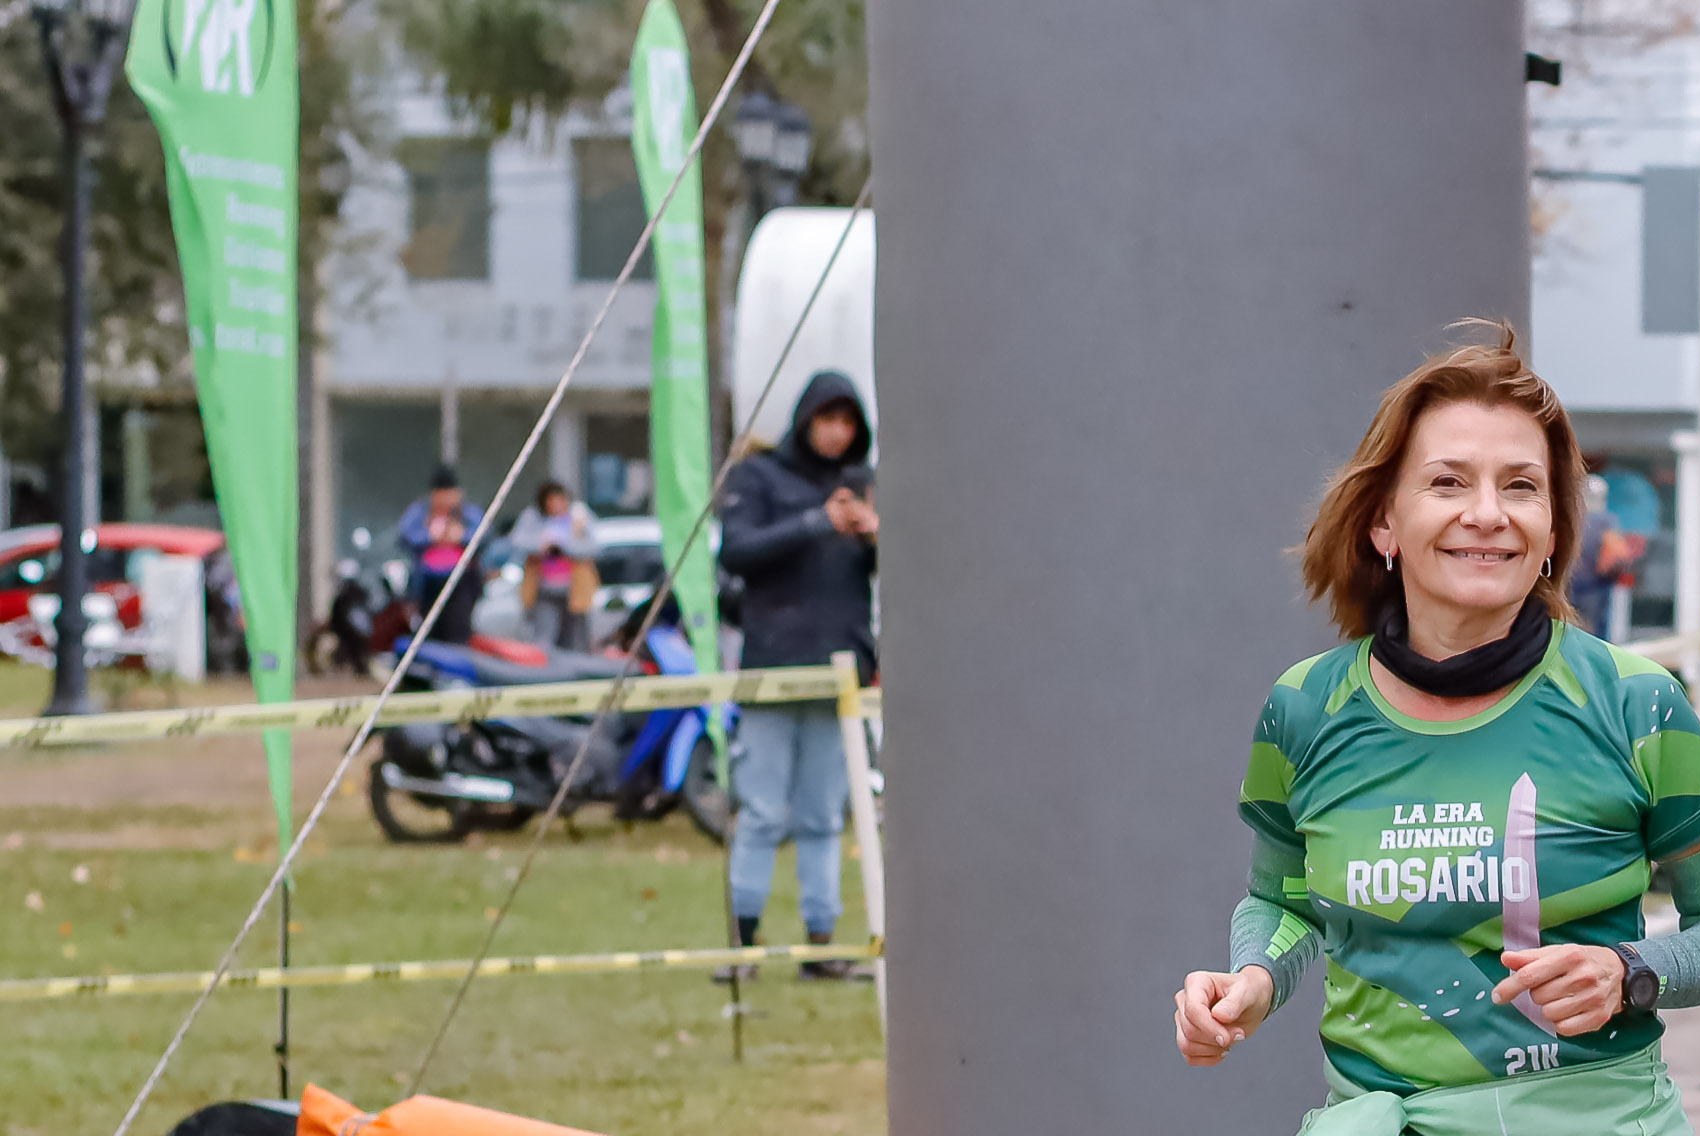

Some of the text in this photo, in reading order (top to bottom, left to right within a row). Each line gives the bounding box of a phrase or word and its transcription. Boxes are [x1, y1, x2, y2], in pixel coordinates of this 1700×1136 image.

[1392, 802, 1484, 825] LA ERA
[1379, 826, 1495, 850] RUNNING
[1346, 855, 1531, 906] ROSARIO
[1504, 1043, 1560, 1076] 21K
